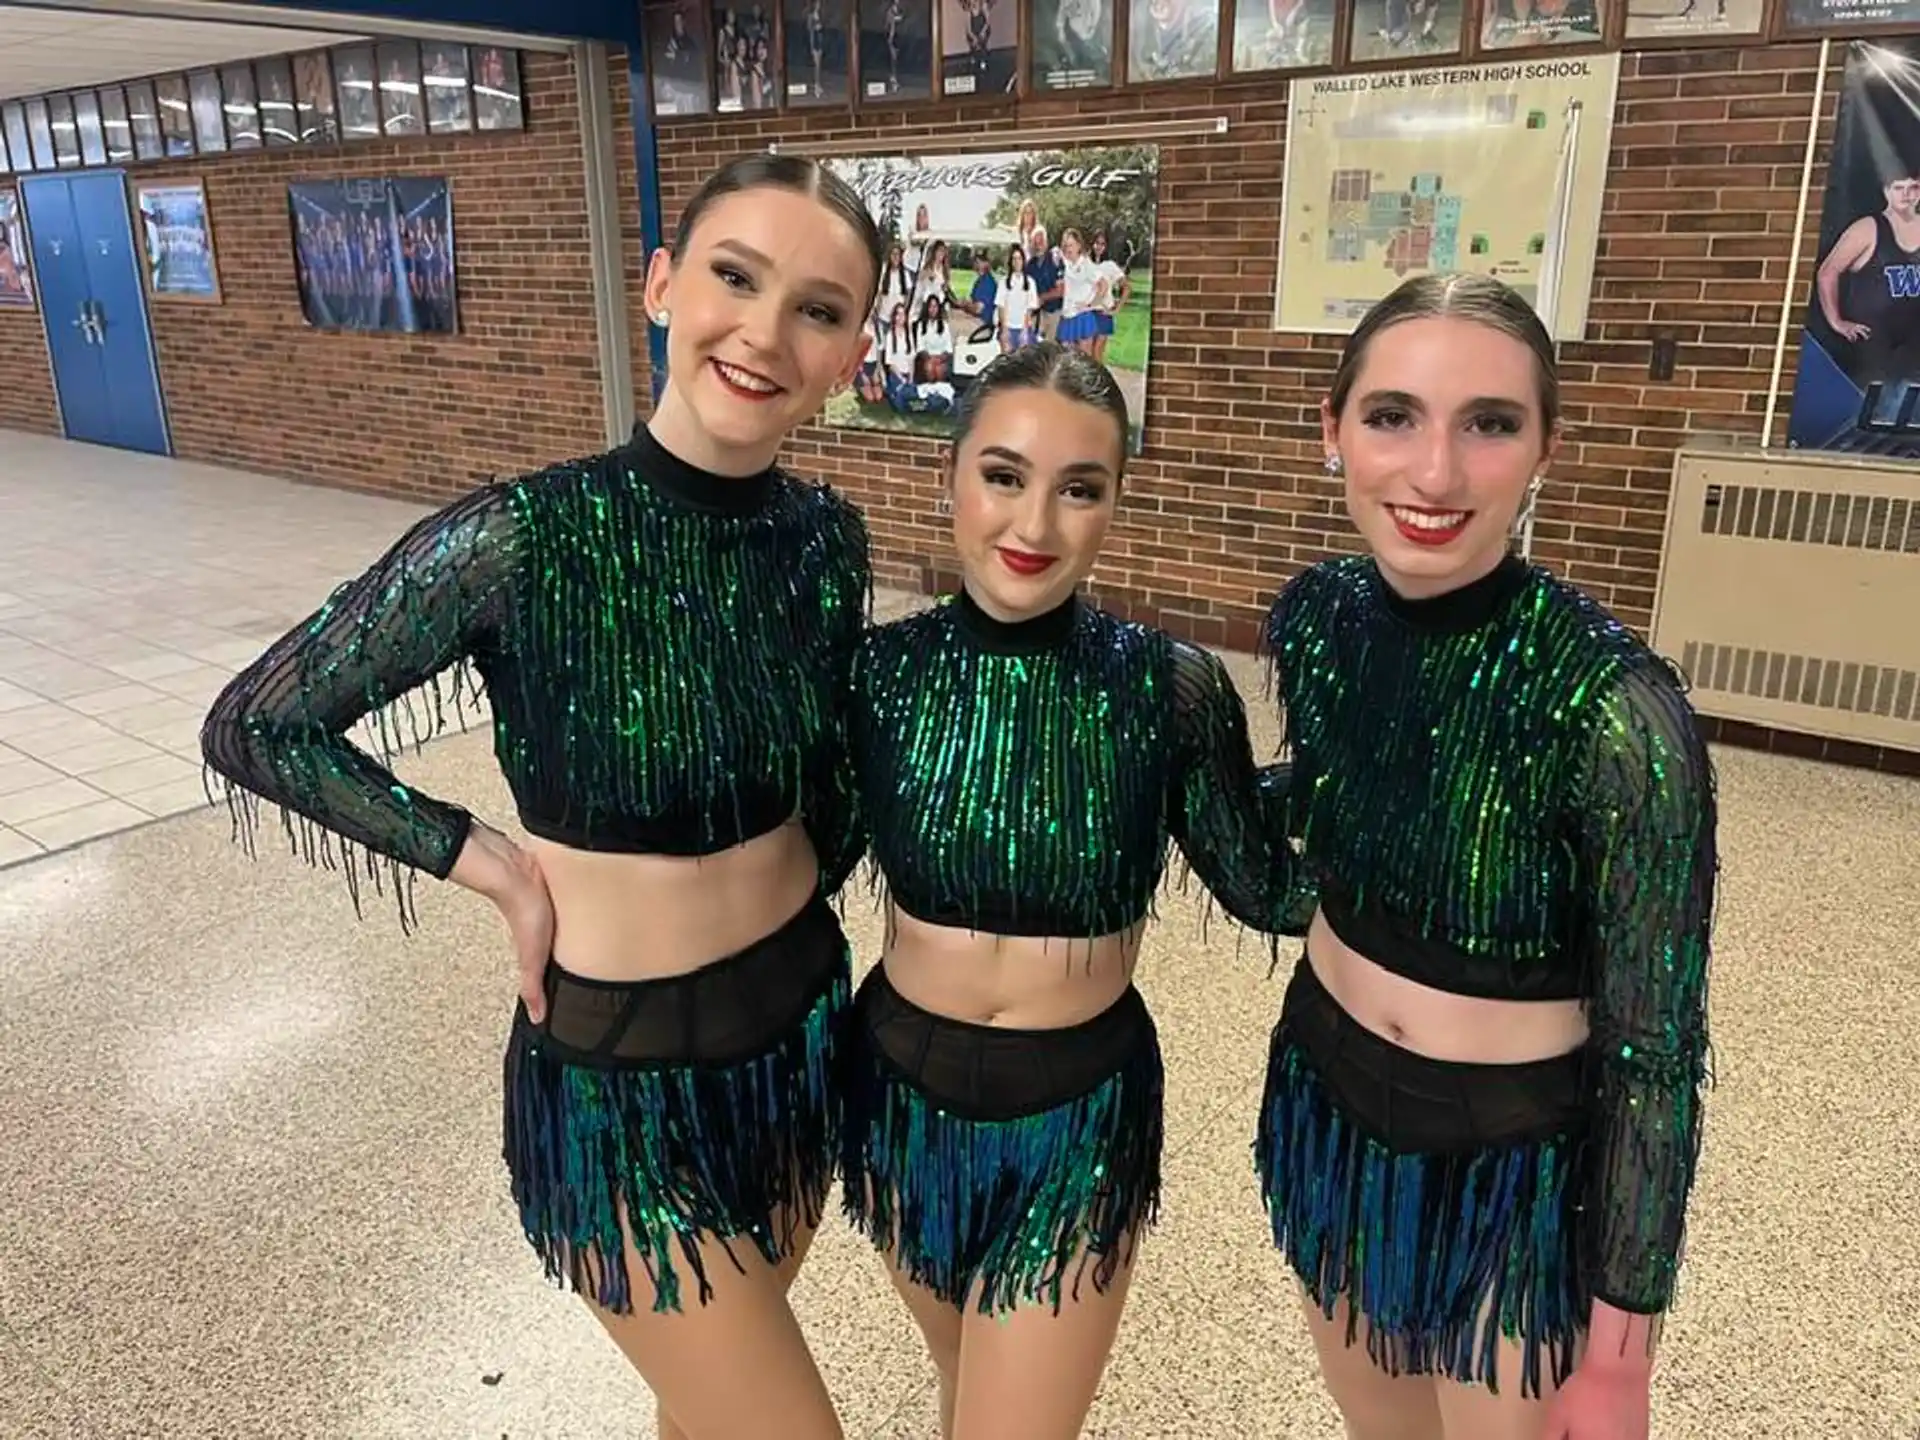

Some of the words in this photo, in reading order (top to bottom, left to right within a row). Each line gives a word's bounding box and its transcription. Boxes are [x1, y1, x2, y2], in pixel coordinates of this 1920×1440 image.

[1313, 78, 1367, 94] WALLED
[1371, 73, 1405, 90] LAKE
[1409, 68, 1481, 87] WESTERN
[1483, 66, 1522, 82] HIGH
[1525, 61, 1592, 78] SCHOOL
[1031, 163, 1141, 191] GOLF
